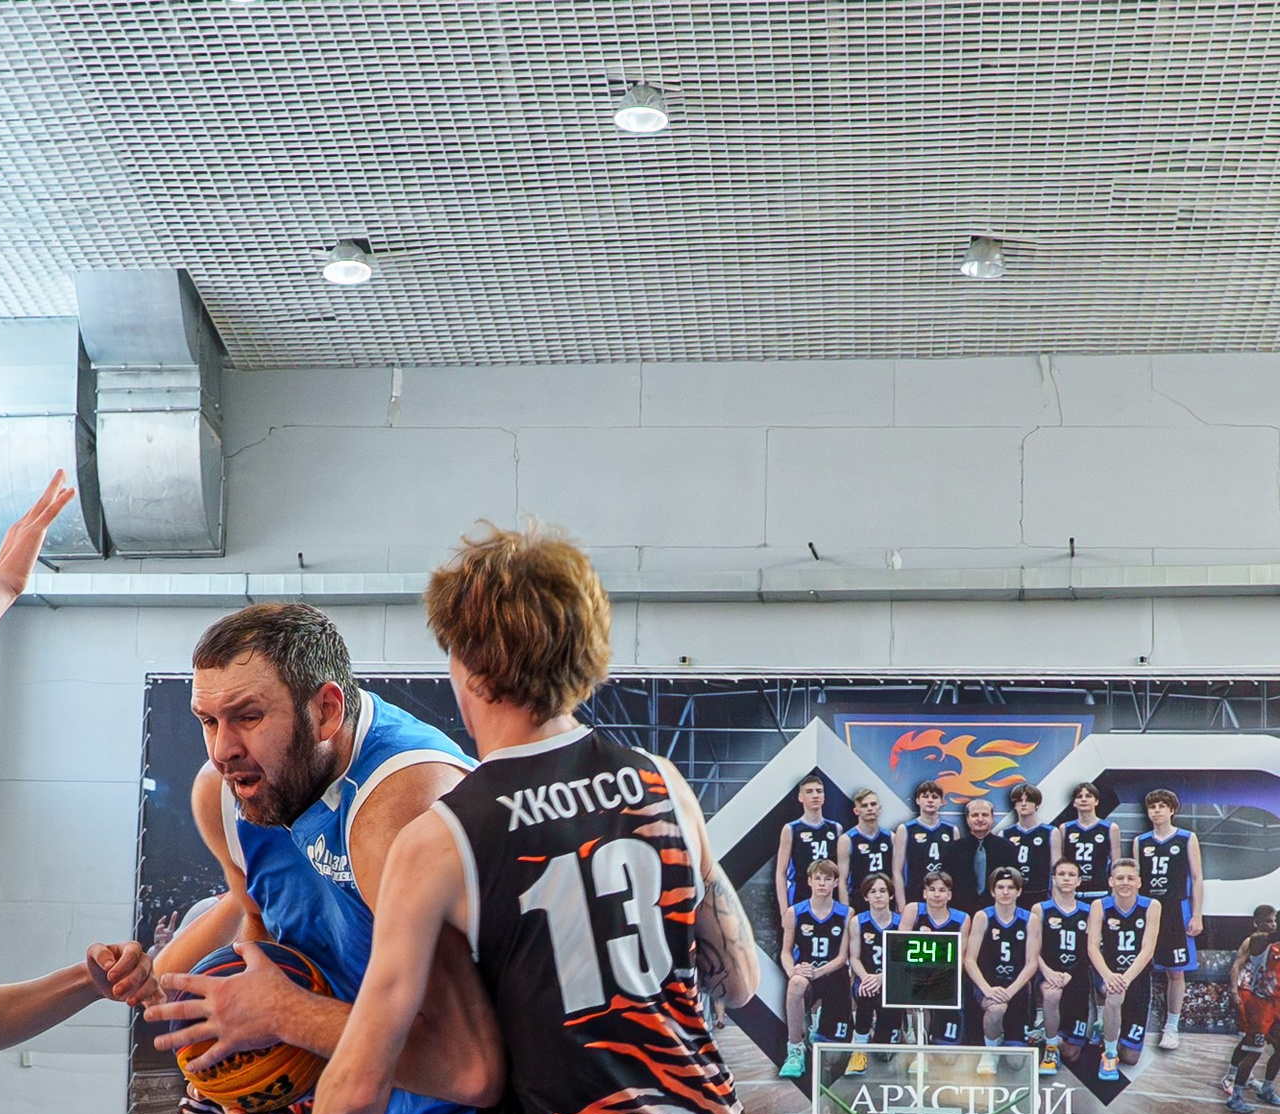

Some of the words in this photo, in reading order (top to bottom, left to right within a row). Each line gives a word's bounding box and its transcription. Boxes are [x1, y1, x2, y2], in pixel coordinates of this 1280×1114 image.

[811, 840, 828, 860] 34
[929, 842, 939, 860] 4
[1017, 846, 1028, 863] 8
[1075, 843, 1093, 861] 22
[869, 852, 883, 871] 23
[1151, 856, 1169, 875] 15
[519, 837, 674, 1014] 13
[811, 937, 829, 957] 13
[1059, 930, 1076, 950] 19
[1118, 930, 1136, 951] 12
[872, 945, 883, 964] 2
[1000, 941, 1011, 962] 5
[1173, 948, 1186, 963] 15
[834, 1022, 848, 1038] 13
[944, 1021, 958, 1039] 11
[1073, 1020, 1087, 1037] 19
[1128, 1023, 1144, 1041] 12
